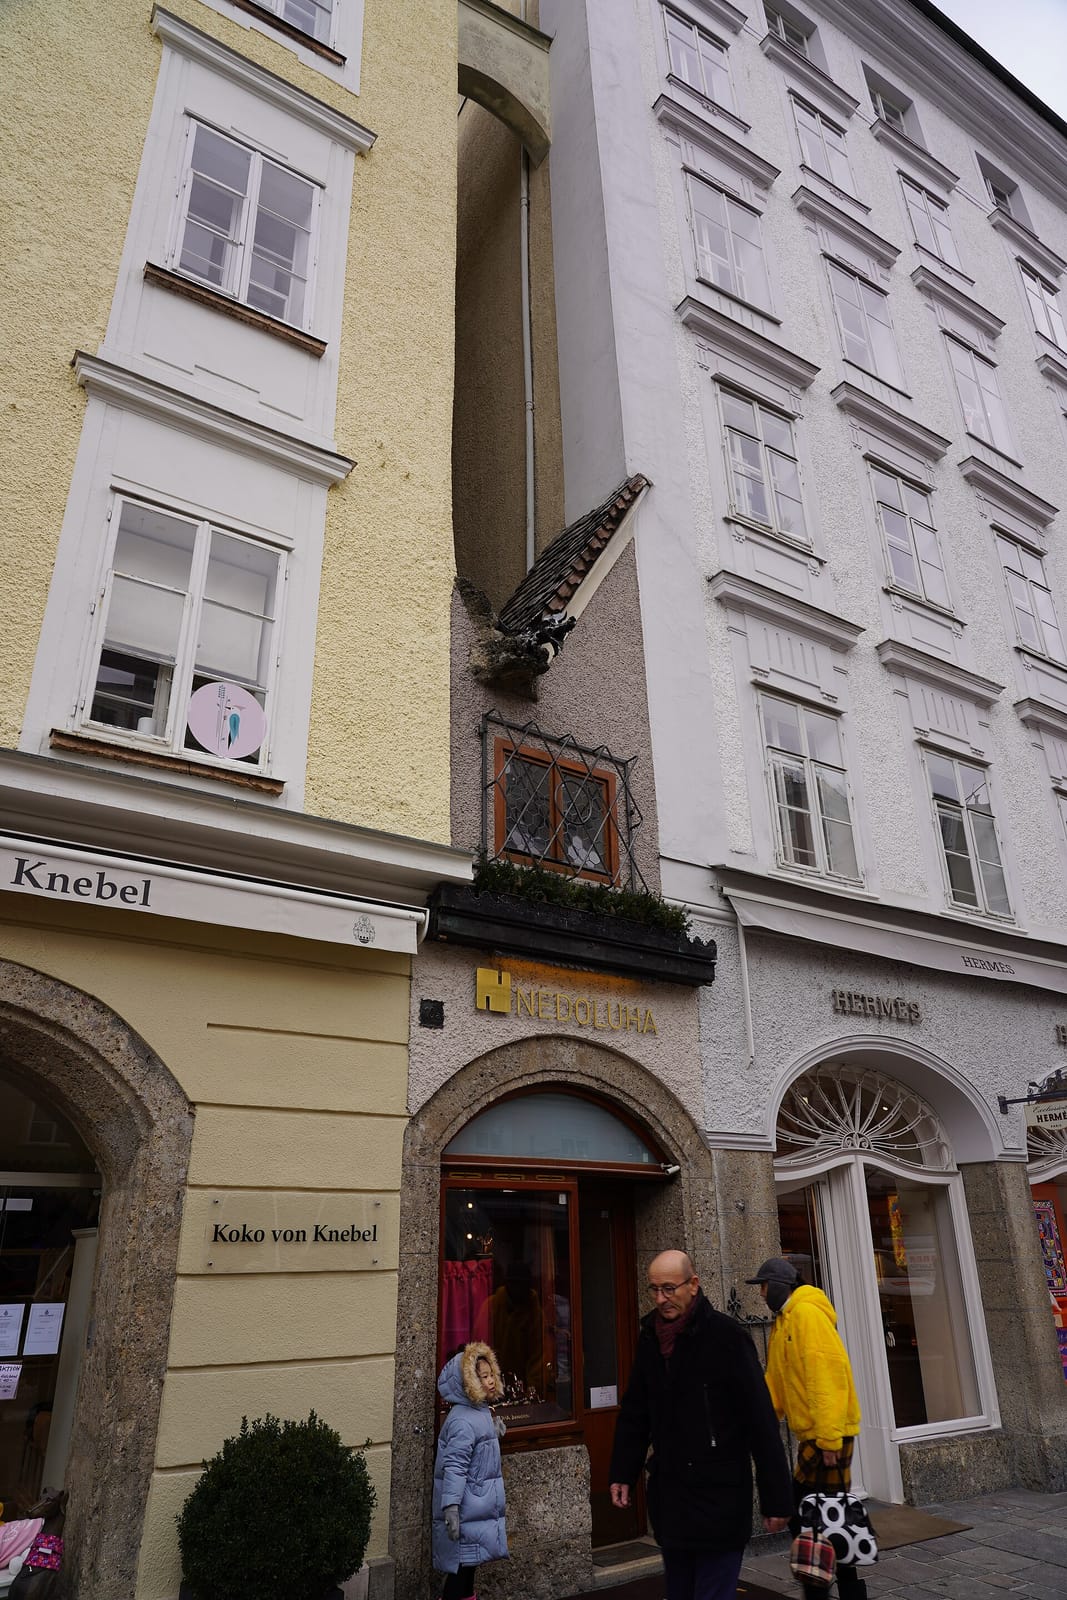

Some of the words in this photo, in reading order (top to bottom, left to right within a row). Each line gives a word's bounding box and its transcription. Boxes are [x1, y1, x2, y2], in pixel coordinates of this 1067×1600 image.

[10, 857, 152, 907] Knebel
[516, 987, 659, 1036] NEDOLUHA
[212, 1223, 265, 1243] Koko
[271, 1229, 307, 1243] von
[313, 1224, 378, 1242] Knebel
